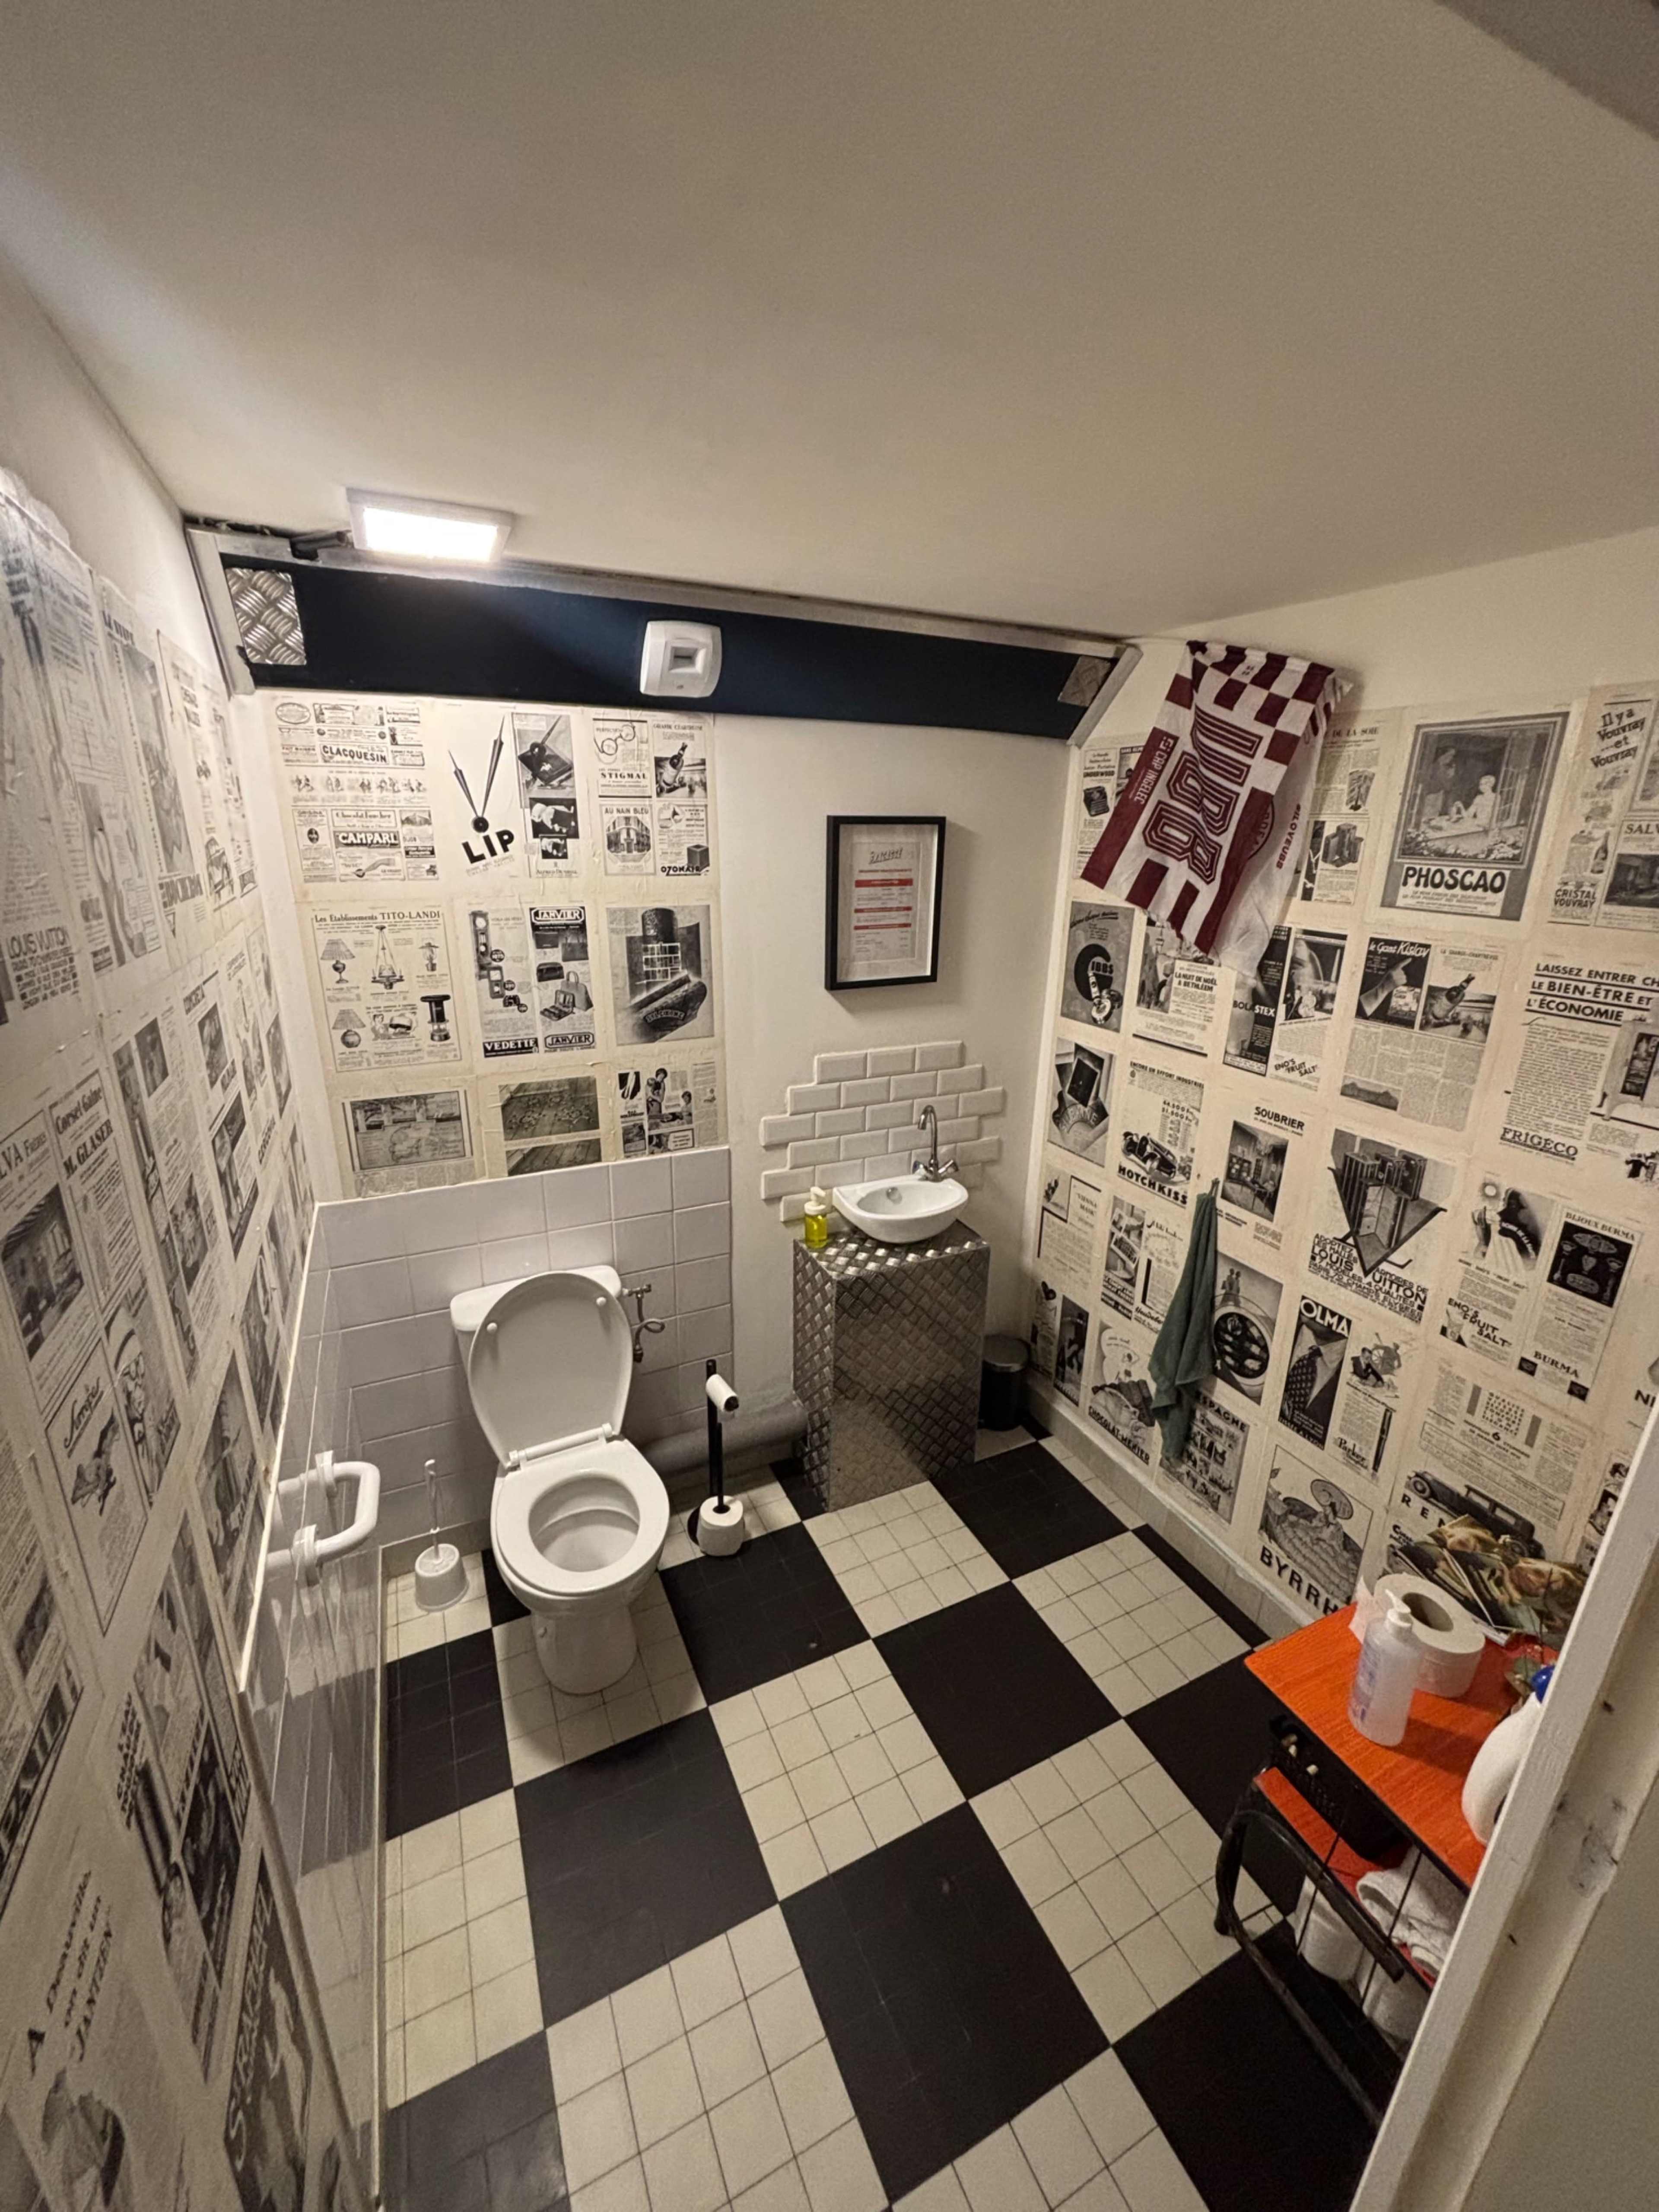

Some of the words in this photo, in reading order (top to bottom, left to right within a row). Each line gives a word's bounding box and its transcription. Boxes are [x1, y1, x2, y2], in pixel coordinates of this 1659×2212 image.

[1597, 717, 1646, 741] Vouvray
[322, 745, 387, 763] CLACQUESIN
[1152, 751, 1168, 771] CAP
[1134, 769, 1159, 805] INGELEC
[1402, 866, 1506, 893] PHOSCAO
[1554, 898, 1596, 908] VOUVRAY
[1555, 889, 1596, 900] CRISTAL
[379, 911, 440, 920] TITO-LANDI
[536, 909, 581, 920] JANVIER
[1535, 963, 1583, 977] LAISSEZ
[1587, 969, 1637, 984] ENTRER
[1532, 981, 1544, 990] LE
[1547, 981, 1634, 1003] BIEN-ÊTRE
[1637, 996, 1653, 1006] ET
[484, 1038, 537, 1051] VEDETTE
[548, 1034, 591, 1046] JANVIER
[1254, 1106, 1306, 1131] SOUBRIER
[76, 1118, 113, 1166] GLASER
[1118, 1165, 1188, 1205] HOTCHKISS
[1601, 1224, 1636, 1242] BURMA
[1311, 1245, 1354, 1271] LOUIS
[1300, 1298, 1349, 1337] OLMA
[1448, 1297, 1480, 1319] ENO'S
[1533, 1351, 1580, 1379] BURMA
[1492, 1432, 1501, 1441] 6
[1337, 1437, 1366, 1462] Parker
